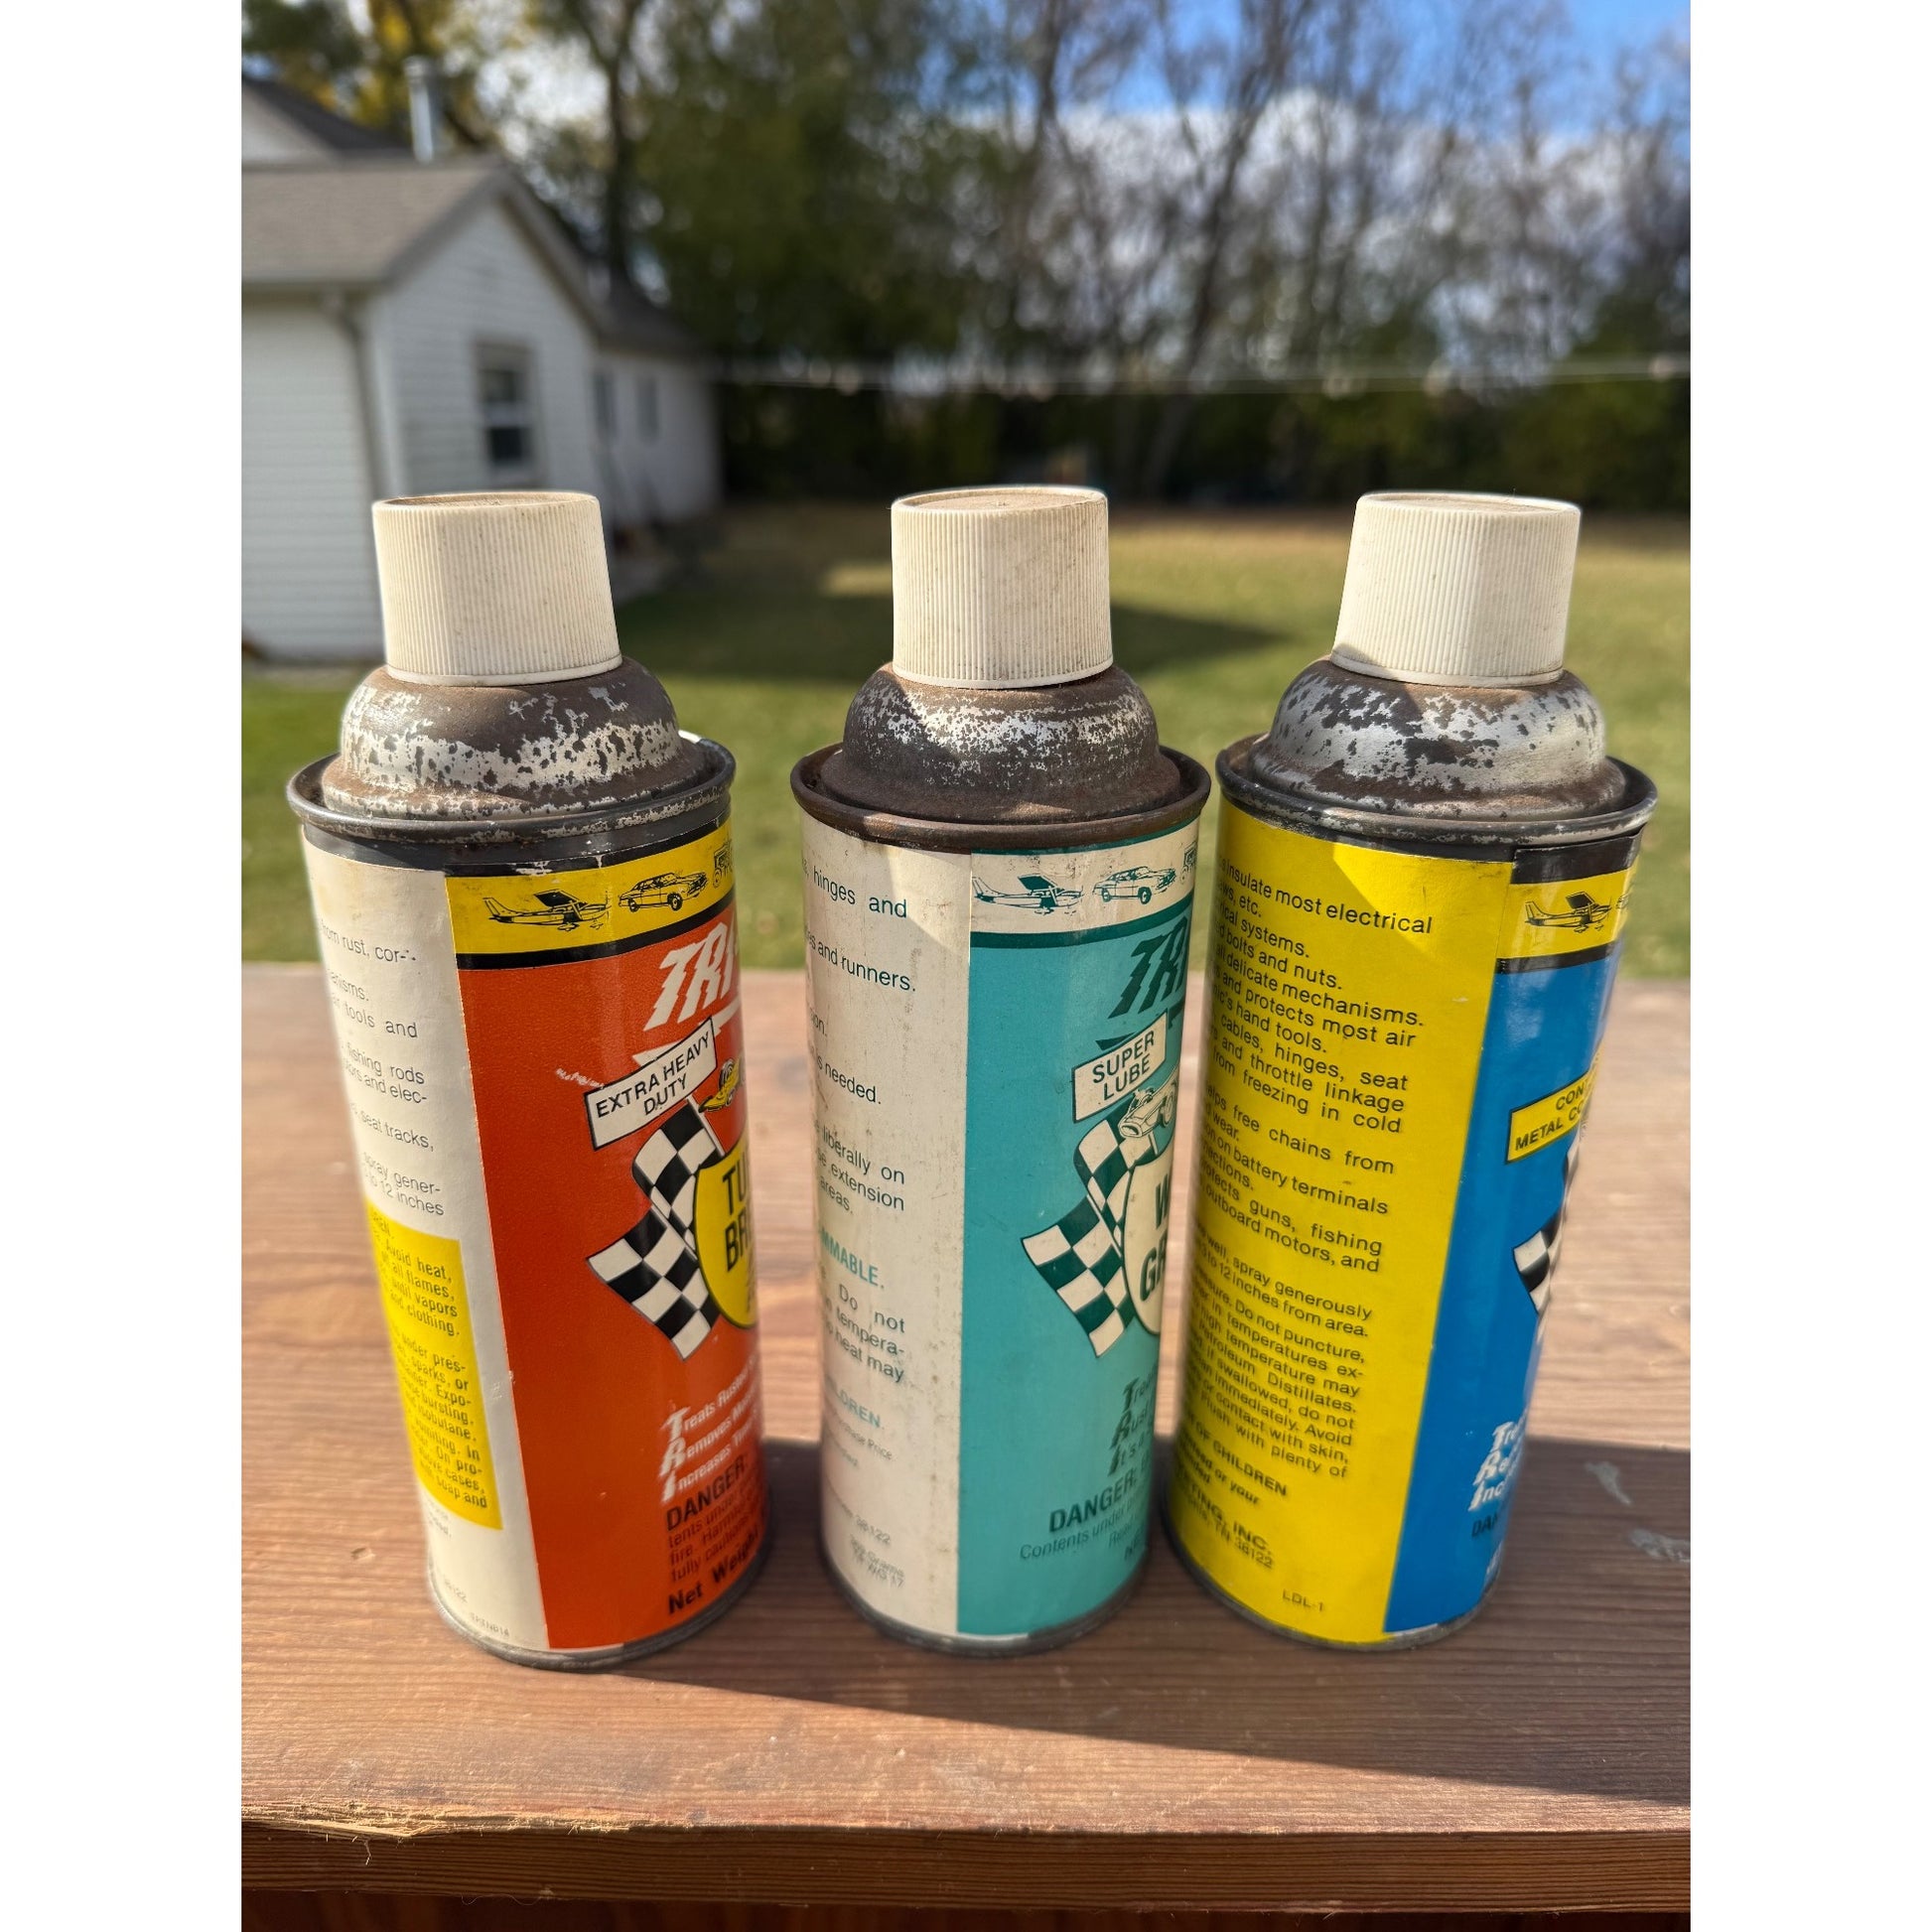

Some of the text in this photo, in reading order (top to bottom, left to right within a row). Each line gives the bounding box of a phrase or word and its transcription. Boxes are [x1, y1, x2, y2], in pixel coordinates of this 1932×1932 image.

[813, 865, 907, 918] hinges and
[1226, 859, 1433, 934] insulate most electrical
[1238, 895, 1262, 918] etc.
[342, 936, 370, 960] rust,
[1226, 927, 1342, 990] bolts and nuts.
[1240, 919, 1310, 959] systems.
[817, 941, 915, 992] and runners.
[1226, 951, 1425, 1027] delicate mechanisms.
[345, 1001, 419, 1038] tools and
[1222, 972, 1417, 1047] and protects most air
[1236, 1000, 1326, 1053] hand tools.
[389, 1065, 426, 1085] rods
[596, 1031, 710, 1118] EXTRA HEAVY
[1092, 1030, 1155, 1084] SUPER
[1220, 1014, 1409, 1091] cables, hinges, seat
[1221, 1036, 1405, 1114] and throttle linkage
[363, 1073, 428, 1104] and elec-
[643, 1072, 688, 1116] DUTY
[825, 1061, 882, 1105] needed.
[1103, 1055, 1151, 1102] LUBE
[1212, 1045, 1402, 1134] from freezing in cold
[384, 1121, 435, 1153] tracks,
[1211, 1111, 1240, 1142] wear.
[1232, 1104, 1394, 1174] free chains from
[1515, 1117, 1565, 1152] METAL
[822, 1124, 872, 1175] liberally
[881, 1166, 905, 1185] on
[1216, 1136, 1389, 1215] on battery terminals
[393, 1172, 441, 1194] gener-
[396, 1187, 445, 1216] inches
[830, 1163, 904, 1212] extension
[1205, 1183, 1381, 1273] outboard motors, and
[1249, 1199, 1383, 1258] guns, fishing
[406, 1269, 456, 1303] flames,
[417, 1257, 453, 1284] heat,
[1232, 1256, 1271, 1288] spray
[1275, 1281, 1373, 1321] generously
[407, 1304, 460, 1337] clothing.
[414, 1292, 459, 1317] vapors
[838, 1284, 859, 1311] Do
[874, 1311, 905, 1333] not
[1232, 1272, 1279, 1309] inches
[1283, 1300, 1321, 1326] from
[1324, 1317, 1369, 1337] area.
[834, 1327, 863, 1362] heat
[867, 1354, 904, 1384] may
[836, 1307, 905, 1356] tempera-
[1227, 1311, 1328, 1371] temperatures
[1336, 1364, 1364, 1379] ex-
[1235, 1299, 1366, 1364] Do not puncture,
[433, 1353, 467, 1373] pres-
[455, 1378, 470, 1392] or
[1225, 1328, 1316, 1385] temperature
[1322, 1378, 1361, 1398] may
[421, 1389, 475, 1426] bursting.
[436, 1384, 472, 1407] Expo-
[1214, 1373, 1352, 1447] immediately. Avoid
[1216, 1357, 1355, 1430] swallowed, do not
[1267, 1371, 1356, 1413] Distillates.
[659, 1401, 716, 1443] Treats
[1215, 1391, 1348, 1464] contact with skin,
[457, 1459, 483, 1475] pro-
[466, 1445, 481, 1461] In
[659, 1445, 733, 1504] Increases
[1212, 1440, 1288, 1497] CHILDREN
[1235, 1423, 1265, 1449] with
[1270, 1445, 1321, 1474] plenty
[1328, 1464, 1348, 1478] of
[464, 1491, 487, 1508] and
[1230, 1480, 1261, 1506] your
[1020, 1529, 1090, 1562] Contents
[1232, 1521, 1274, 1556] INC.
[668, 1583, 703, 1615] Net
